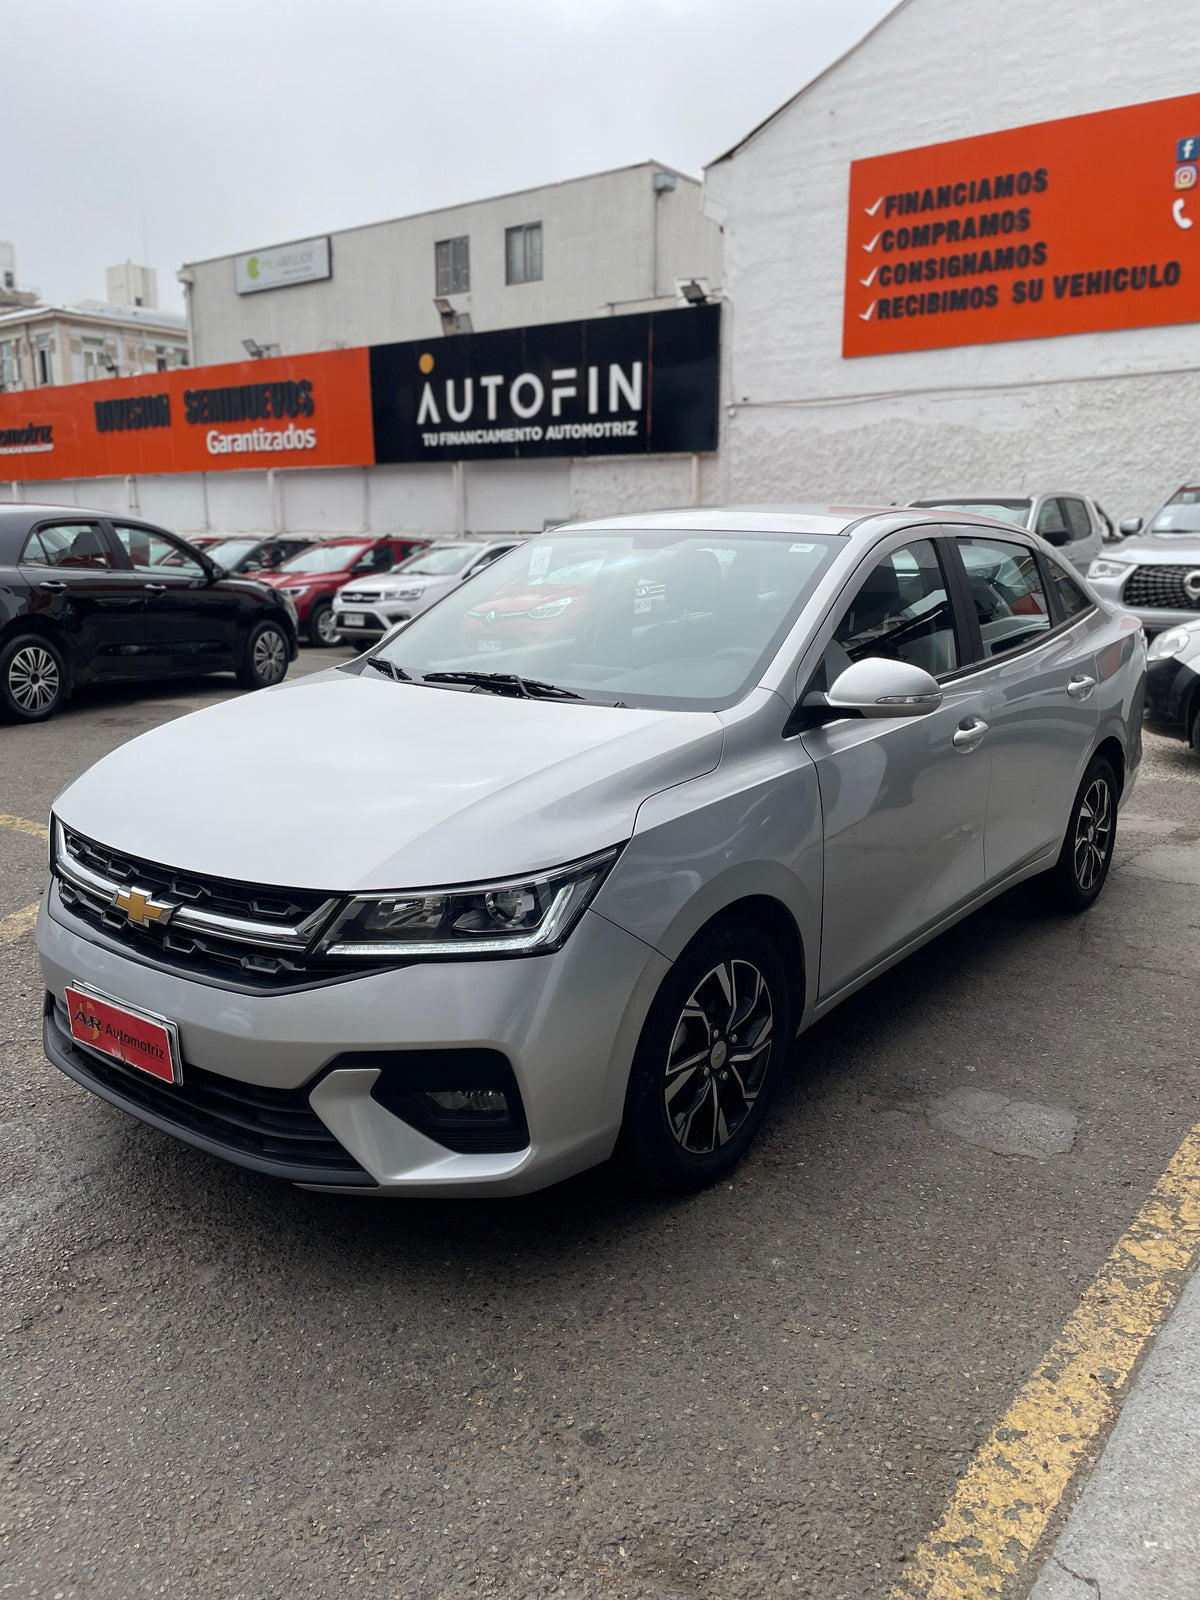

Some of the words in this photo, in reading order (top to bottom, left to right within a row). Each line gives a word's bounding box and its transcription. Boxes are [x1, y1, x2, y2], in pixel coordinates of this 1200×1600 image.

[884, 168, 1048, 218] FINANCIAMOS
[881, 207, 1031, 252] COMPRAMOS
[878, 242, 1047, 286] CONSIGNAMOS
[876, 285, 998, 320] RECIBIMOS
[1011, 279, 1043, 304] SU
[1053, 262, 1181, 299] VEHICULO
[183, 379, 315, 424] SEMINUEVOS
[416, 360, 643, 425] AUTOFIN
[206, 423, 317, 454] Garantizados
[422, 433, 439, 447] TU
[440, 426, 543, 446] FINANCIAMIENTO
[545, 421, 638, 441] AUTOMOTRIZ
[105, 1023, 165, 1060] Automotriz
